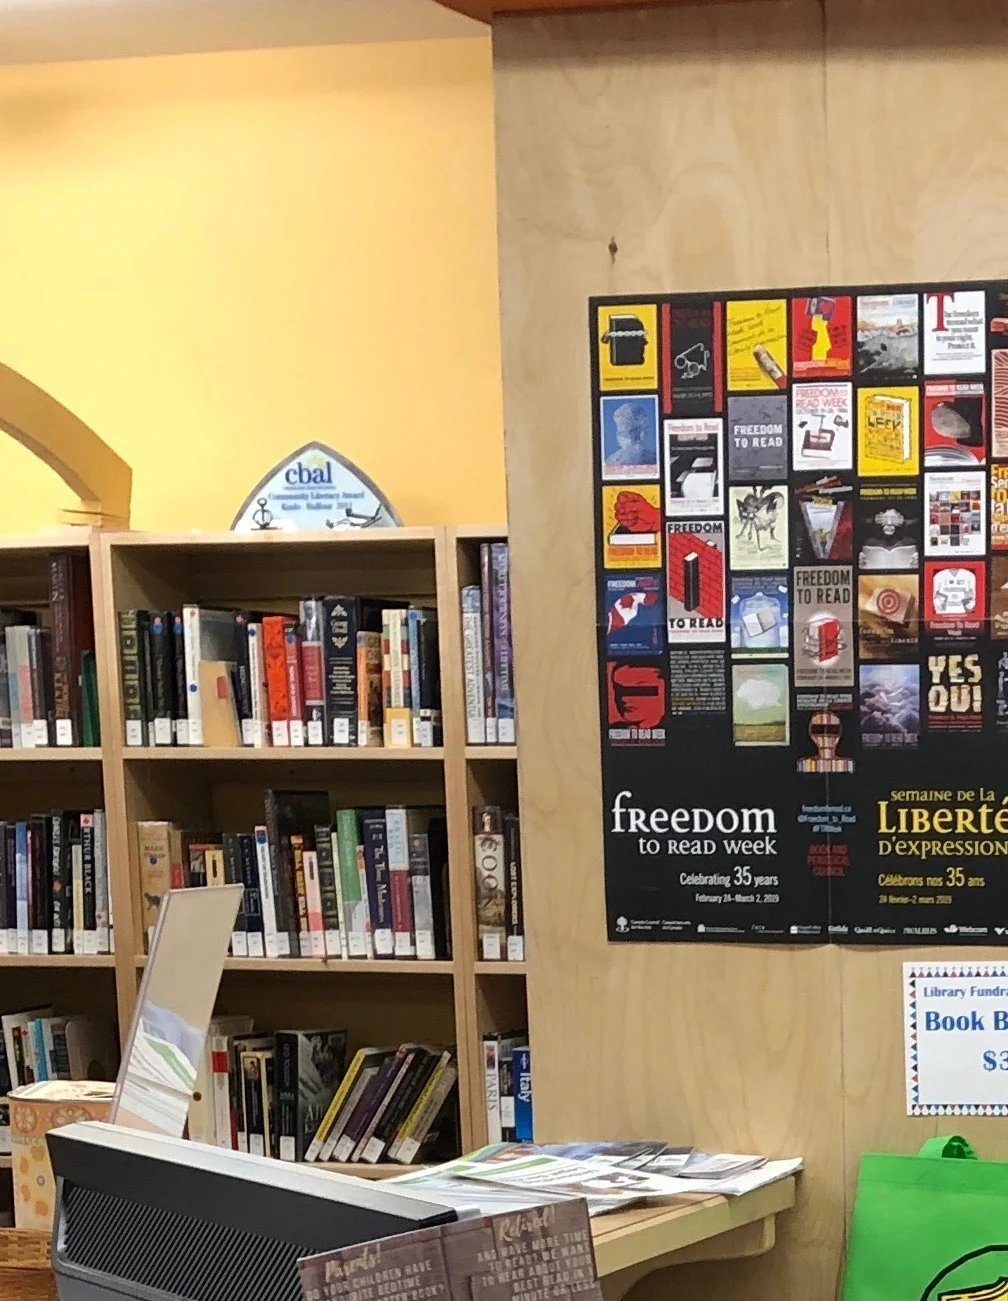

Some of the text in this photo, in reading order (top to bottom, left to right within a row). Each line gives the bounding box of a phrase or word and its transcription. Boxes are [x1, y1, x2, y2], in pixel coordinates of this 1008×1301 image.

[733, 424, 783, 435] FREEDOM
[734, 437, 783, 448] TO READ
[285, 461, 332, 485] cbal
[667, 522, 723, 534] FREEDOM
[796, 569, 851, 587] FREEDOM
[797, 588, 851, 604] TO READ
[669, 618, 724, 629] TO READ
[927, 653, 982, 684] YES
[638, 837, 660, 855] to
[679, 866, 779, 888] Celebrating 35 years
[878, 867, 985, 887] Célébrons nos 35 ans
[923, 985, 966, 1000] Library
[925, 1010, 985, 1031] Book
[487, 1073, 498, 1111] PARIS
[517, 1072, 532, 1103] Italy
